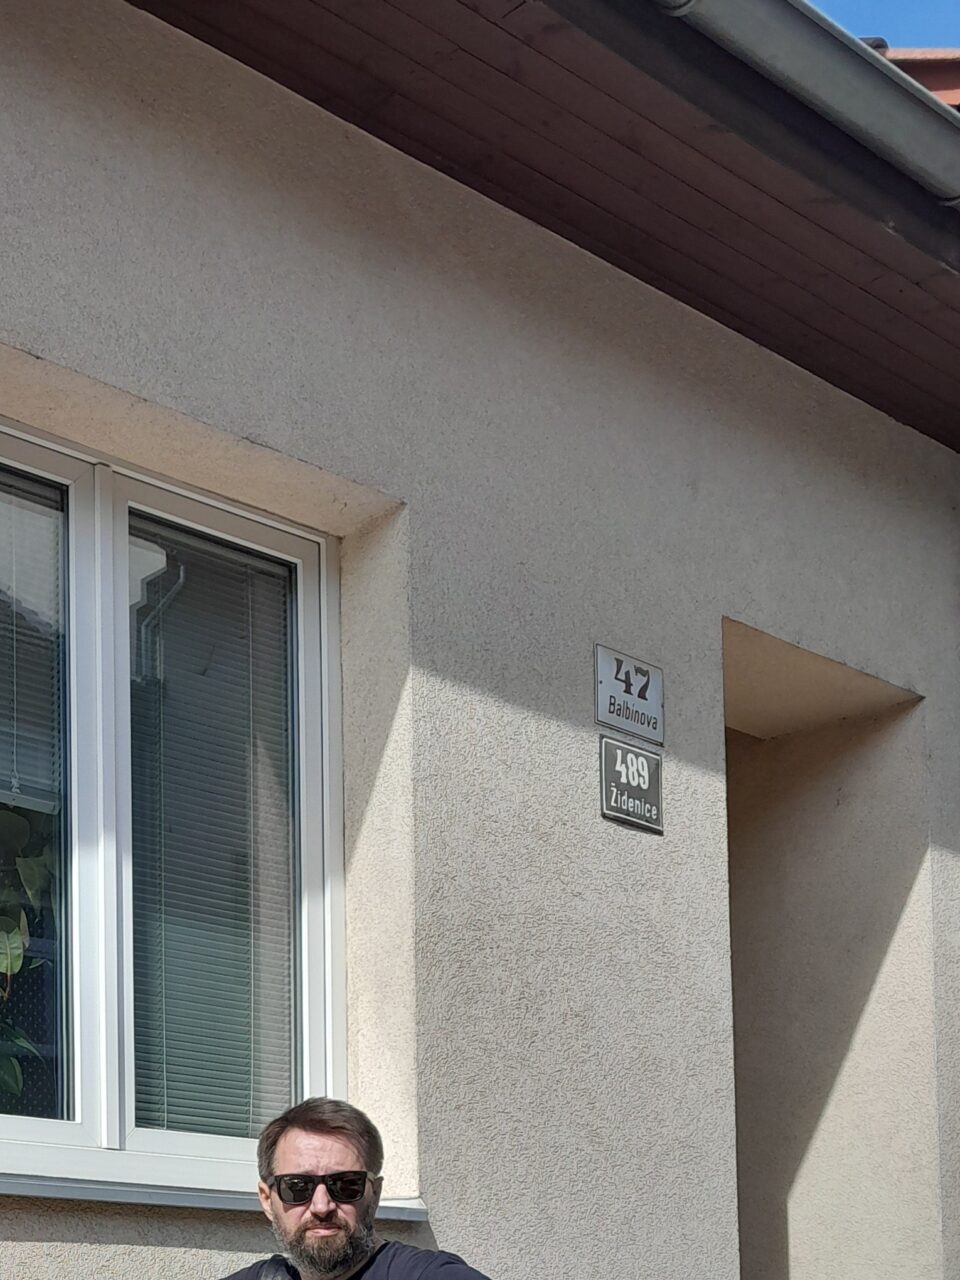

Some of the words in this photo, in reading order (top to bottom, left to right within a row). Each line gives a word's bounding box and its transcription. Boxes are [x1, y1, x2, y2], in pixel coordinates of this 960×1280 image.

[614, 657, 650, 701] 47
[615, 749, 649, 789] 489
[610, 782, 657, 819] Židenice
